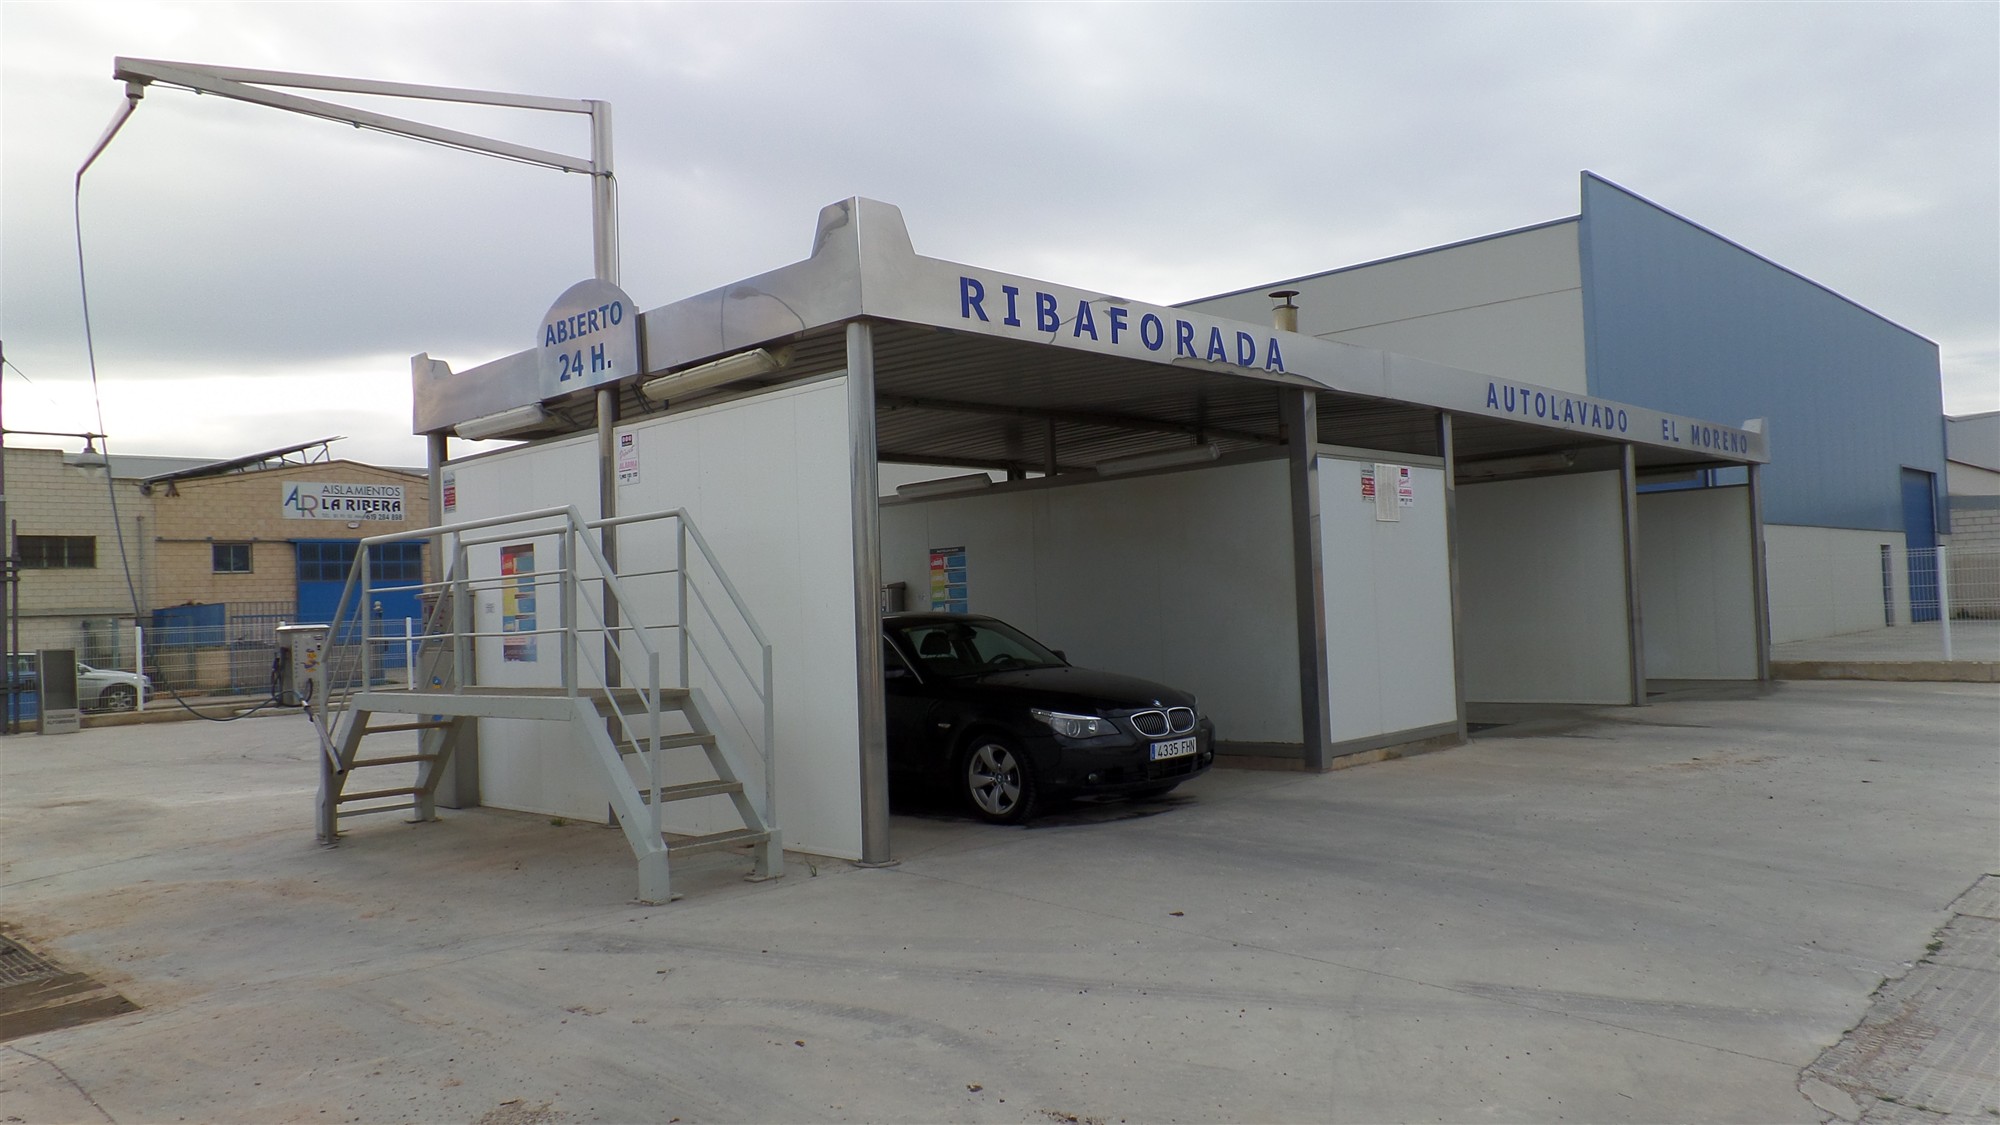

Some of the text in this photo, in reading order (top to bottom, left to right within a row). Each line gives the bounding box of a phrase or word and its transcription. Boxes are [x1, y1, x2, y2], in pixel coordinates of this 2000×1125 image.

[545, 301, 623, 348] ABIERTO
[959, 276, 1285, 372] RIBAFORADA
[559, 342, 612, 382] 24 H.
[1486, 382, 1628, 433] AUTOLAVADO
[1661, 418, 1748, 454] EL MORENO
[322, 485, 401, 496] AISLAMIENTOS
[322, 499, 401, 512] LA RIBERA
[1157, 739, 1194, 757] 4335 FHN
